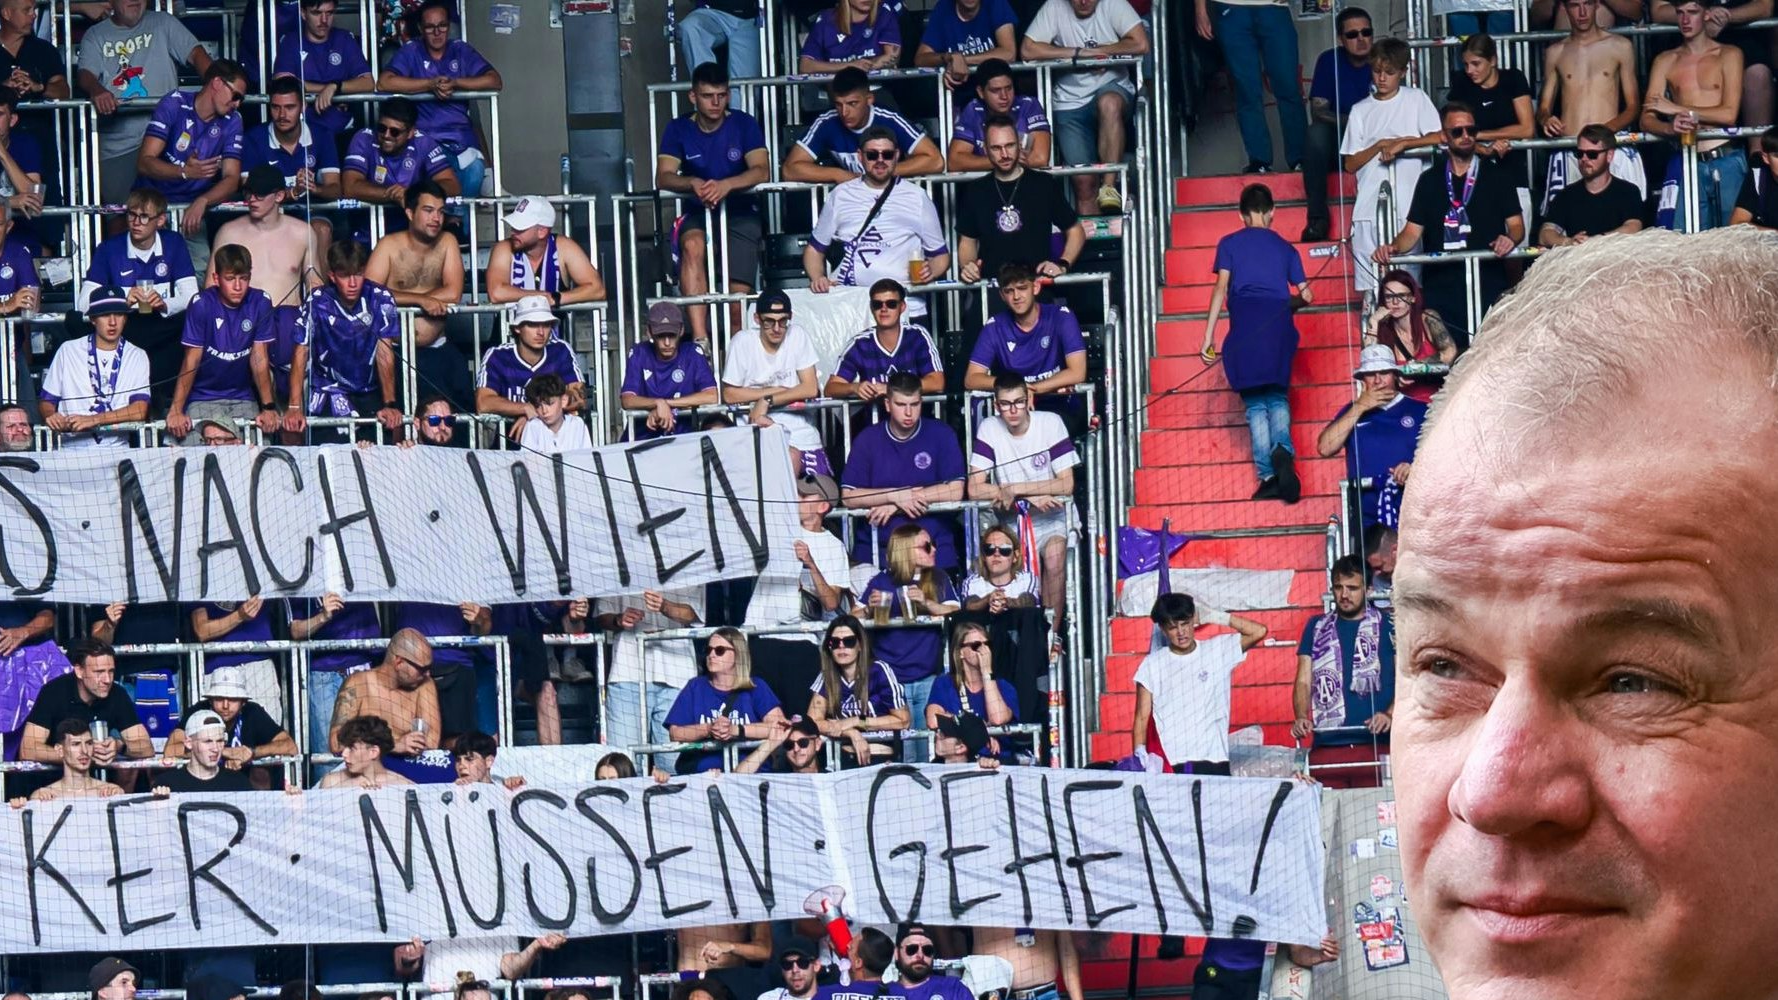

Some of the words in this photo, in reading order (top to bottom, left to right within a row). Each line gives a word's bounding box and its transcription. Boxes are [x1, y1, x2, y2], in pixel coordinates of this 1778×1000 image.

[103, 33, 153, 58] GOOFY
[117, 448, 397, 602] NACH
[466, 425, 770, 596] WIEN
[358, 781, 776, 938] MÜSSEN
[867, 764, 1294, 937] GEHEN!
